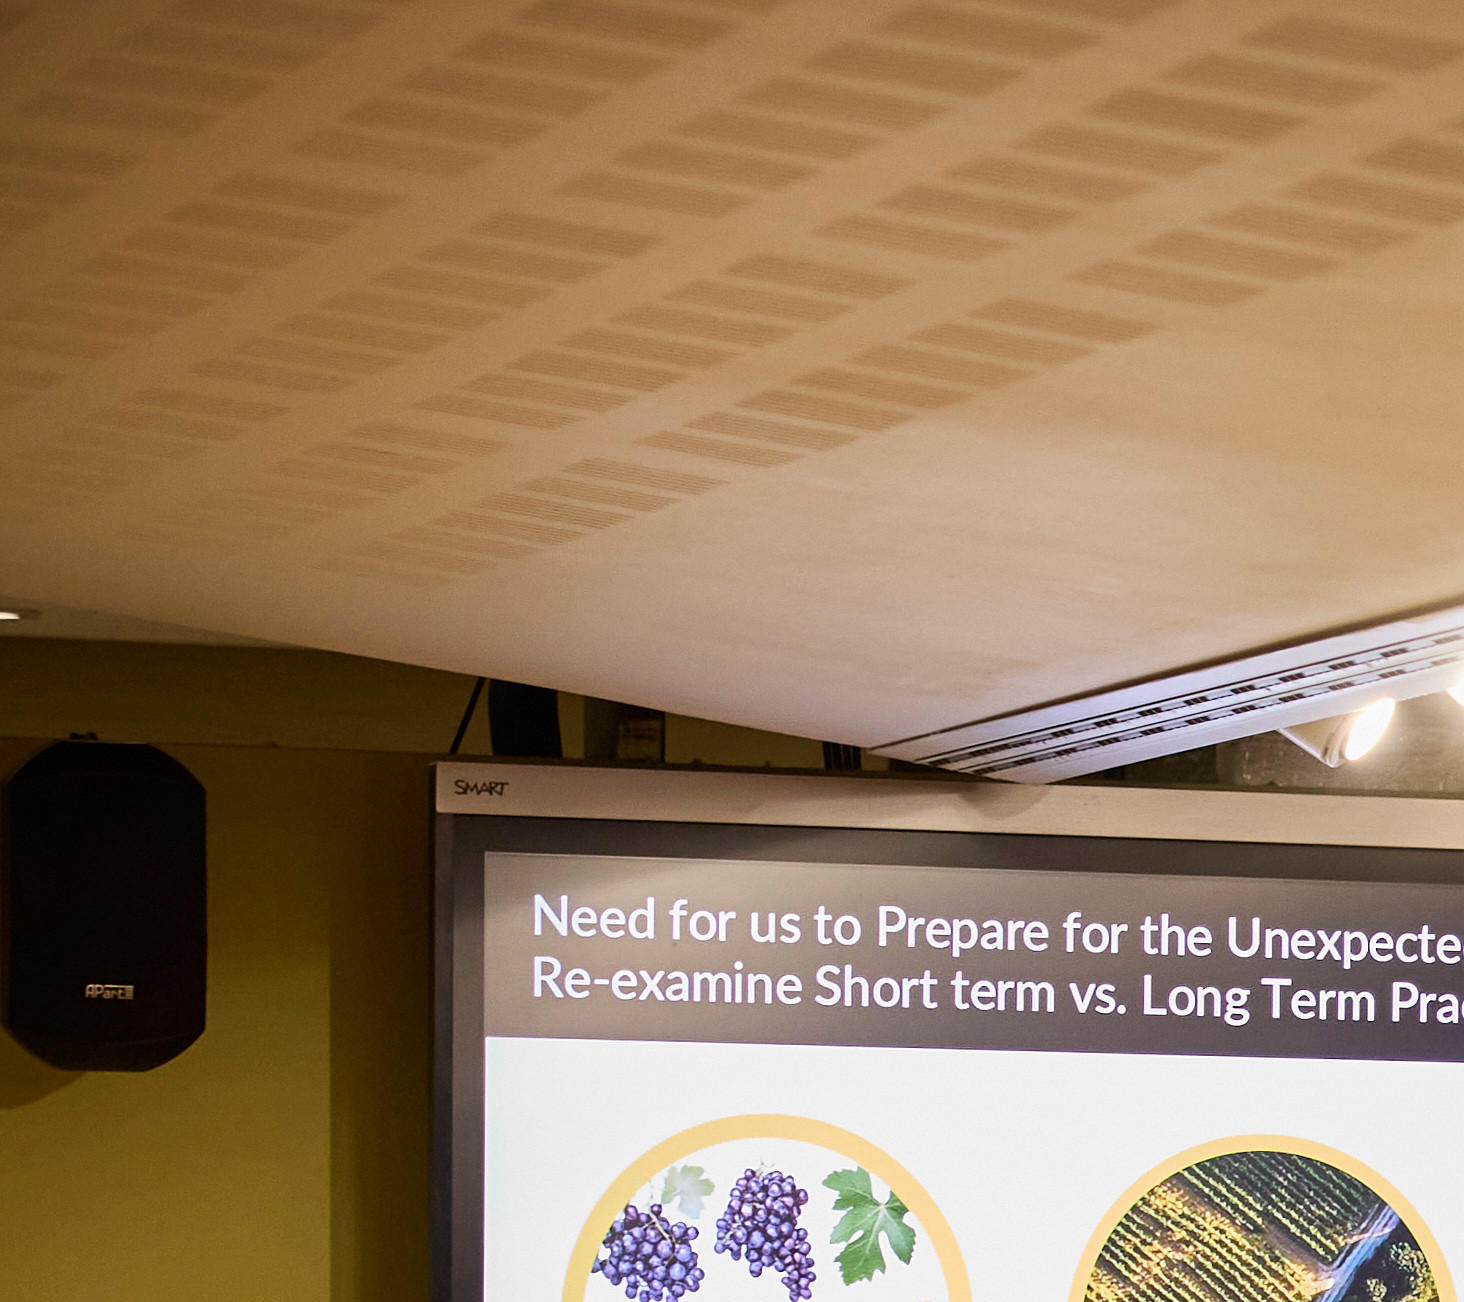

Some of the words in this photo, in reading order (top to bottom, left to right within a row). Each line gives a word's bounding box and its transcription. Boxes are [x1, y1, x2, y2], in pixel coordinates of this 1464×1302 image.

[454, 779, 509, 796] SMART
[534, 894, 655, 939] Need
[669, 899, 736, 941] for
[751, 912, 801, 943] us
[813, 906, 861, 945] to
[879, 906, 1048, 957] Prepare
[1062, 912, 1128, 953] for
[1140, 914, 1212, 956] the
[534, 956, 802, 1004] Re-examine
[815, 964, 938, 1008] Short
[951, 971, 1054, 1012] term
[1069, 983, 1126, 1014] vs.
[1144, 975, 1250, 1026] Long
[1261, 978, 1374, 1021] Term
